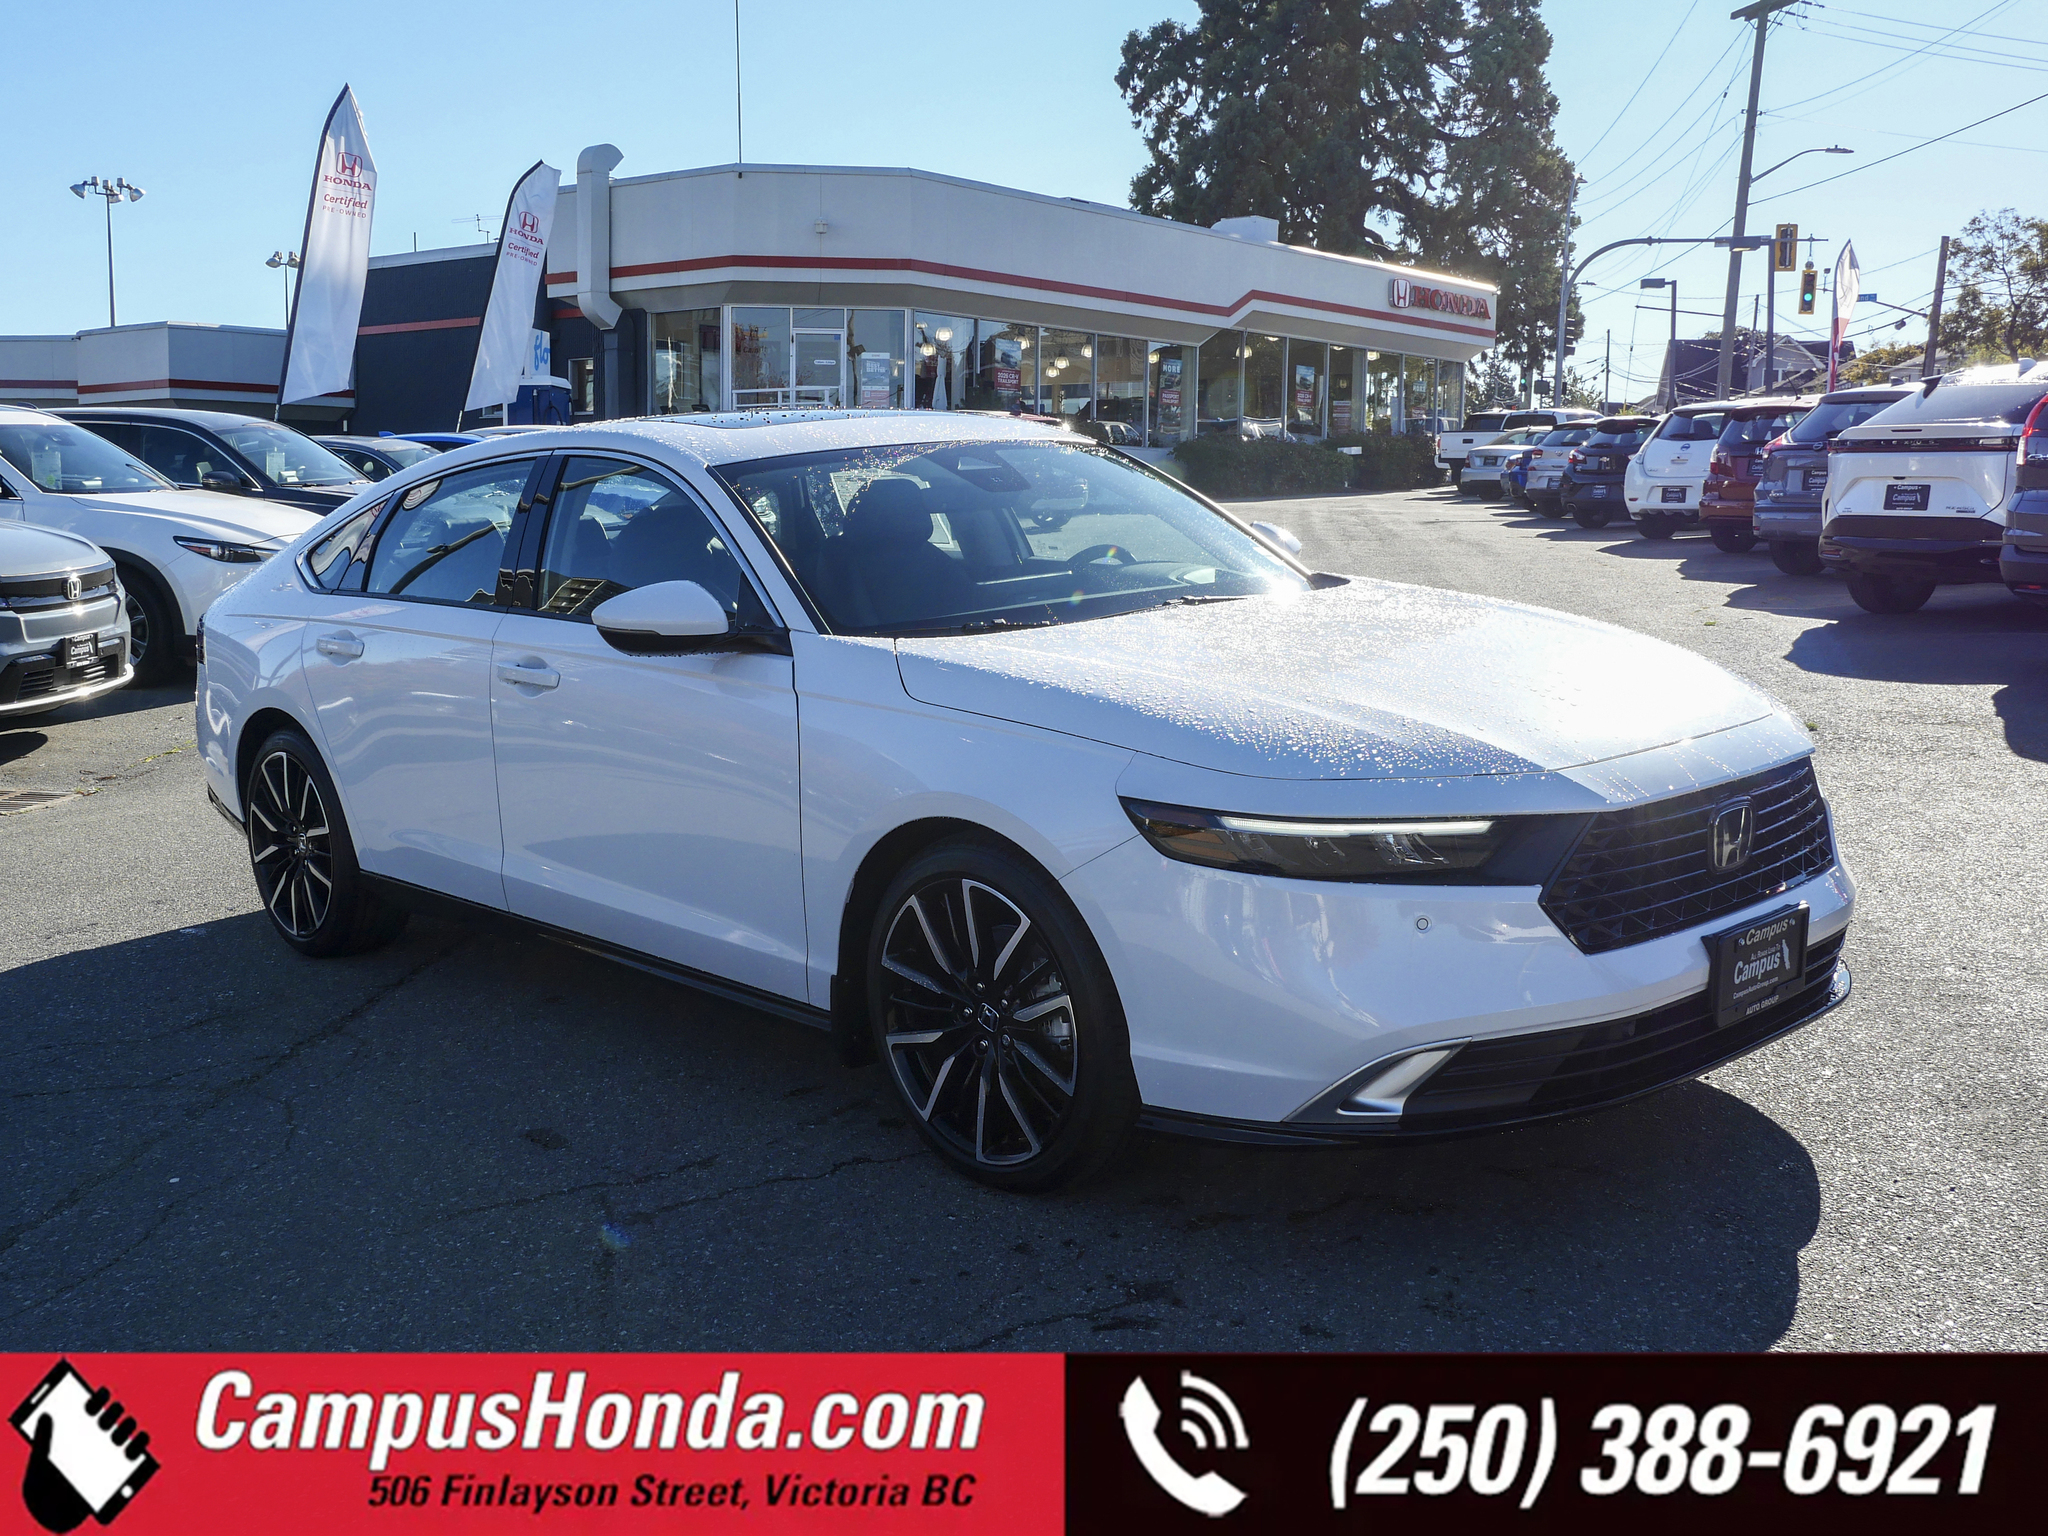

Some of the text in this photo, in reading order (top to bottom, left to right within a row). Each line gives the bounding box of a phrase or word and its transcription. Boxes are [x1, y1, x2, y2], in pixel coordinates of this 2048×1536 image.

[324, 175, 372, 191] HONDA
[324, 194, 368, 209] Certified
[322, 205, 367, 219] PRE-OWNED
[509, 227, 544, 245] HONDA
[506, 252, 538, 266] PRE-OWNED
[508, 243, 540, 259] Certified
[1412, 286, 1491, 320] HONDA
[534, 331, 550, 371] flo
[1162, 364, 1181, 373] MORE
[1892, 493, 1917, 503] Campus
[1746, 918, 1789, 945] Campus
[1734, 952, 1781, 985] Campus
[1733, 976, 1779, 999] CampusAutoGroup.com
[1746, 994, 1780, 1016] AUTO GROUP
